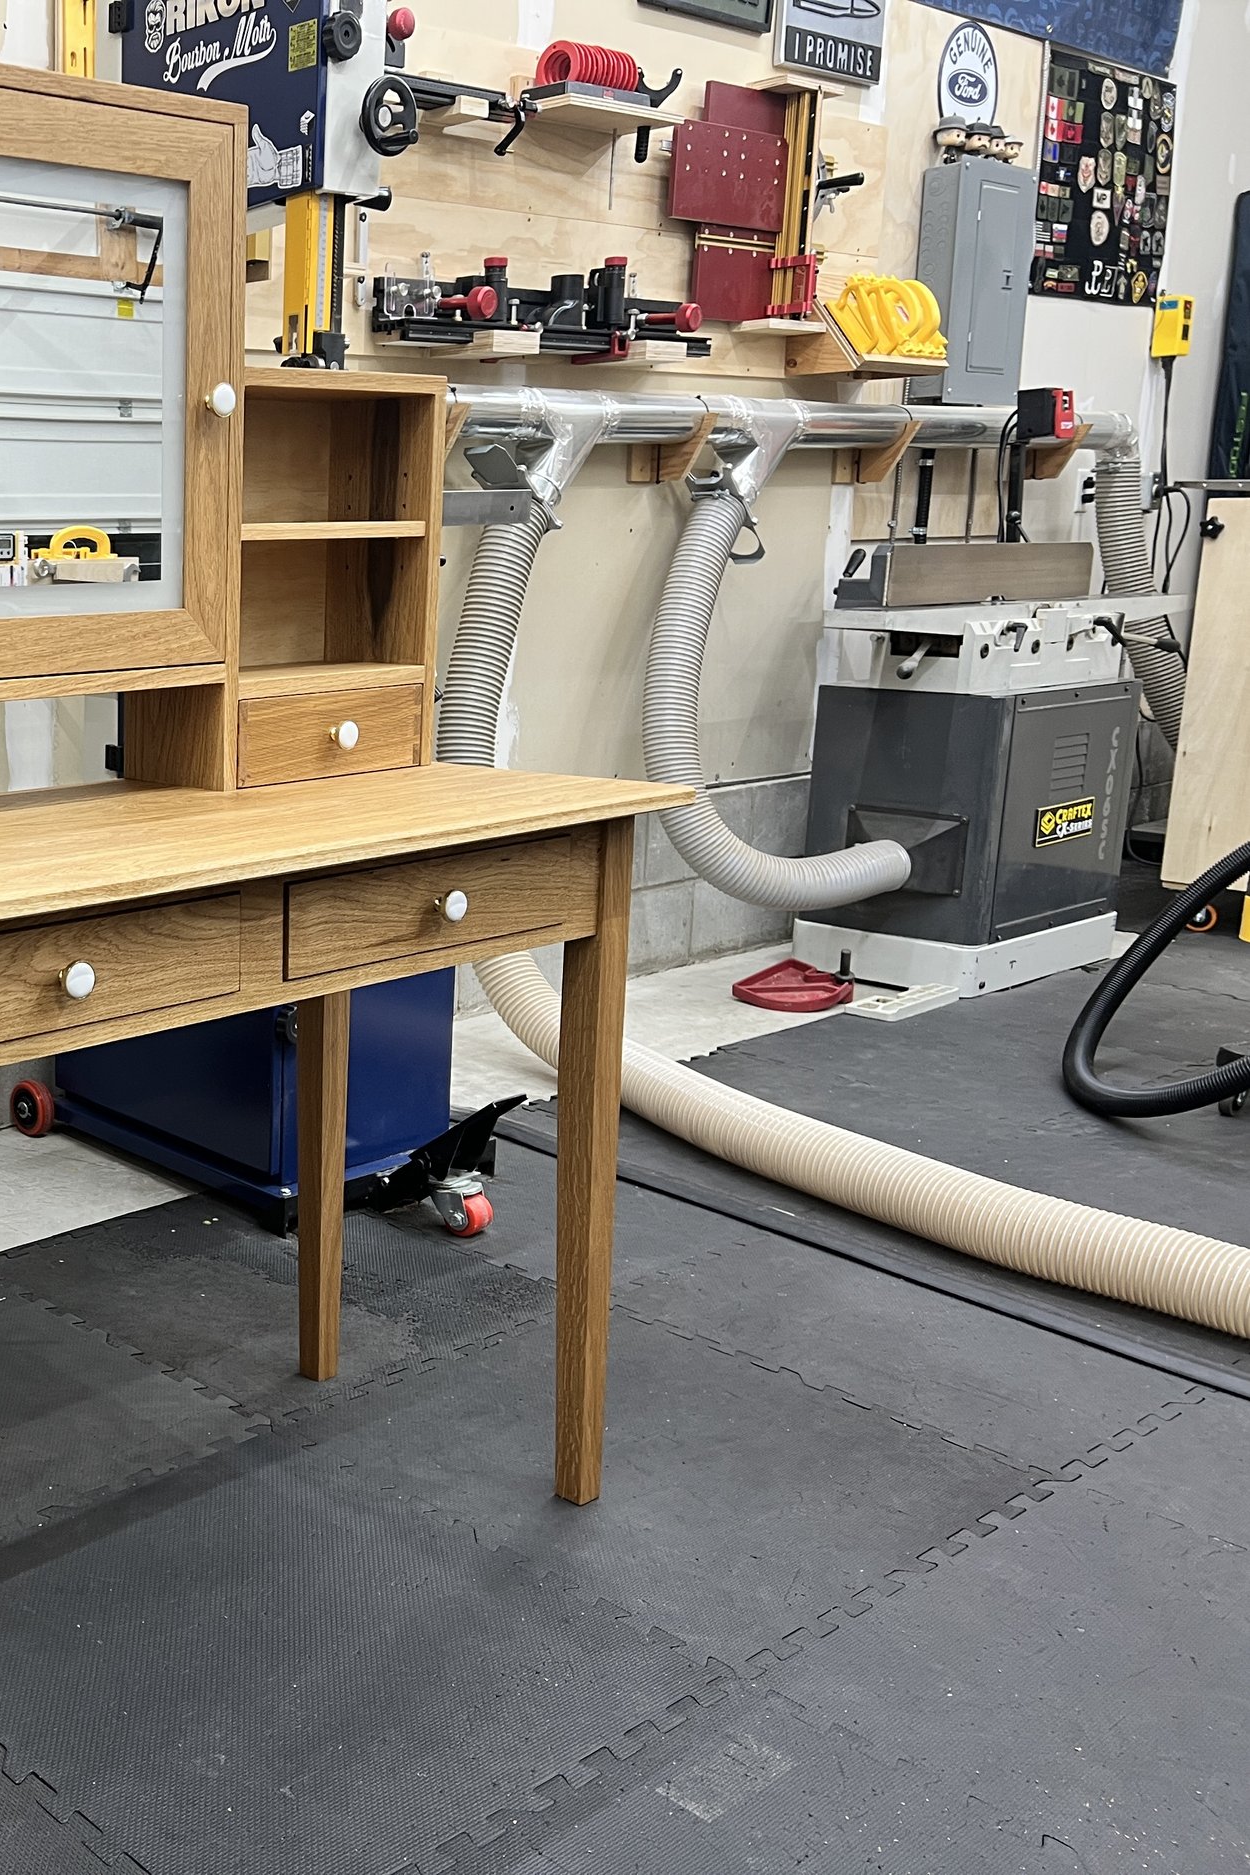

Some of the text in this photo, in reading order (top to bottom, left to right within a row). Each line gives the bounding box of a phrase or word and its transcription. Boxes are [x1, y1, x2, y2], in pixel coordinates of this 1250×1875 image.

[163, 37, 221, 84] Bourbon
[223, 12, 272, 60] Moth
[794, 32, 873, 76] I PROMISE
[949, 30, 993, 74] GENUINE
[954, 73, 982, 100] Ford
[1055, 803, 1092, 824] CRAFTEX
